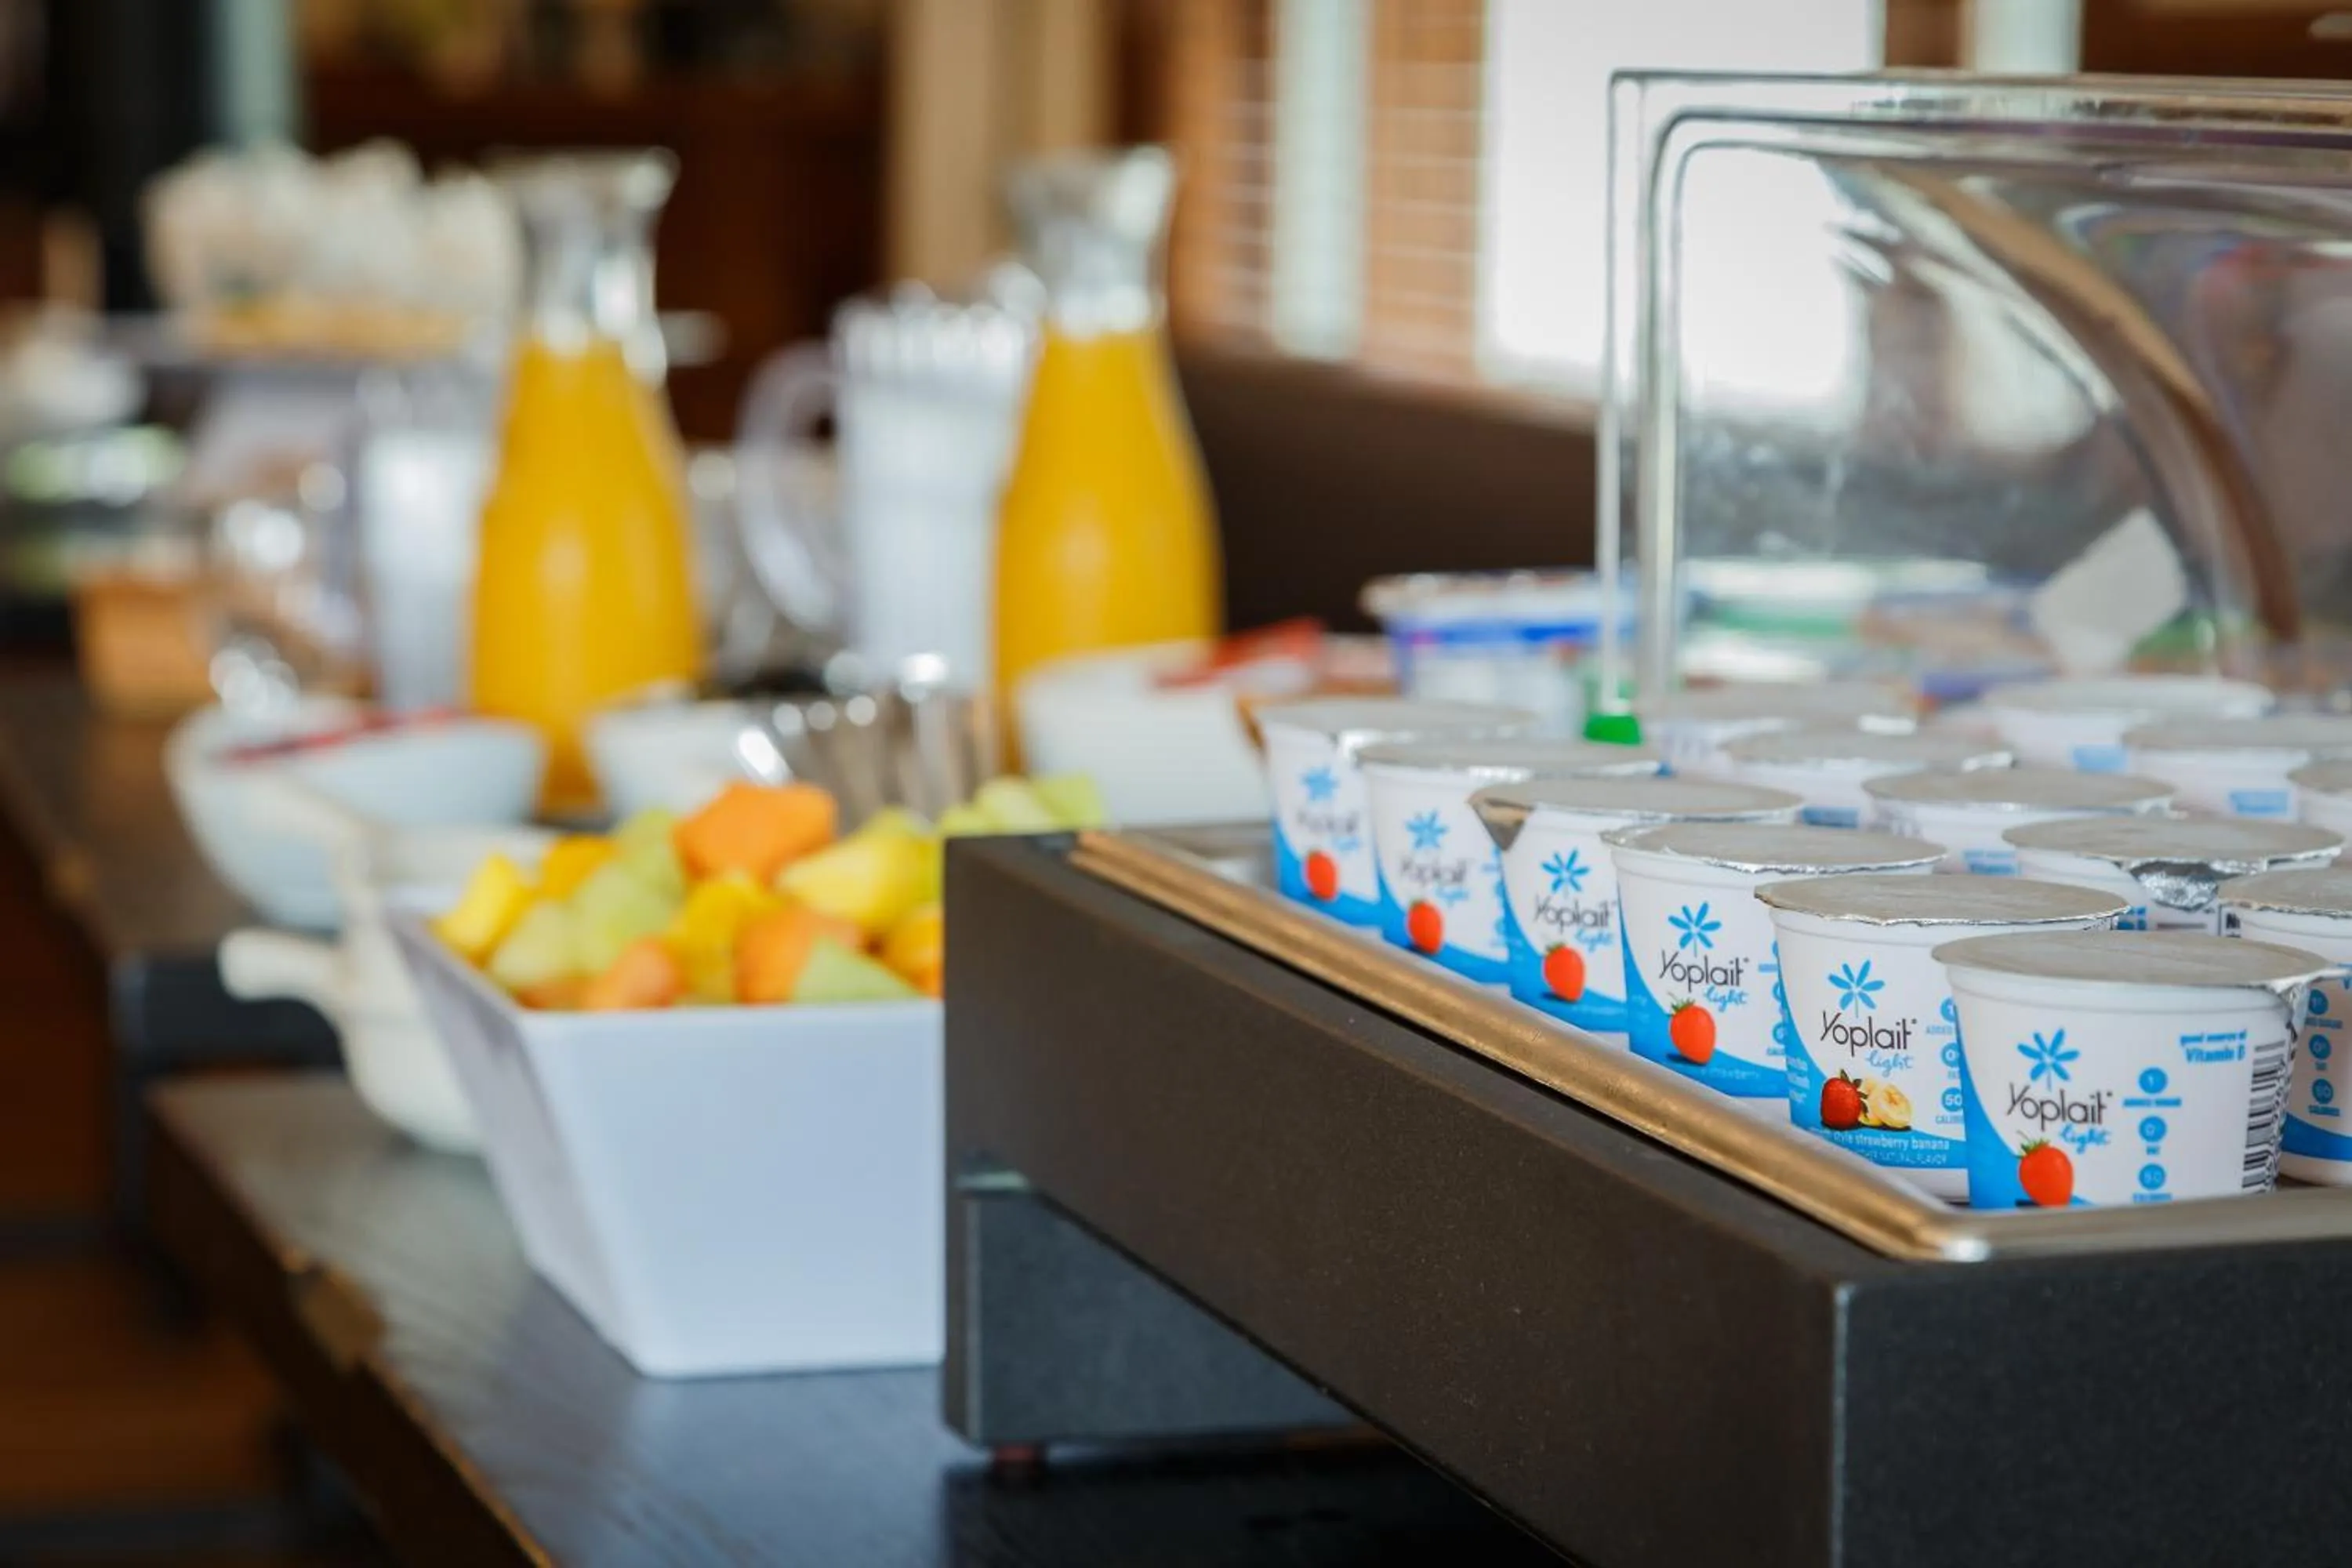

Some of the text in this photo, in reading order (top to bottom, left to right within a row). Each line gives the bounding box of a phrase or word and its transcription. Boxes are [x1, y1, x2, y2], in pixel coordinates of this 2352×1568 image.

[1534, 893, 1610, 934] Yoplait
[1659, 949, 1744, 993] Yoplait
[1704, 985, 1747, 1012] light
[1820, 1010, 1911, 1058] Yoplait
[1865, 1050, 1913, 1077] light
[2185, 1046, 2234, 1063] Vitamin
[2006, 1080, 2107, 1132] Yoplait
[1856, 1132, 1909, 1151] strawberry
[1911, 1138, 1950, 1150] banana
[2060, 1123, 2111, 1155] light
